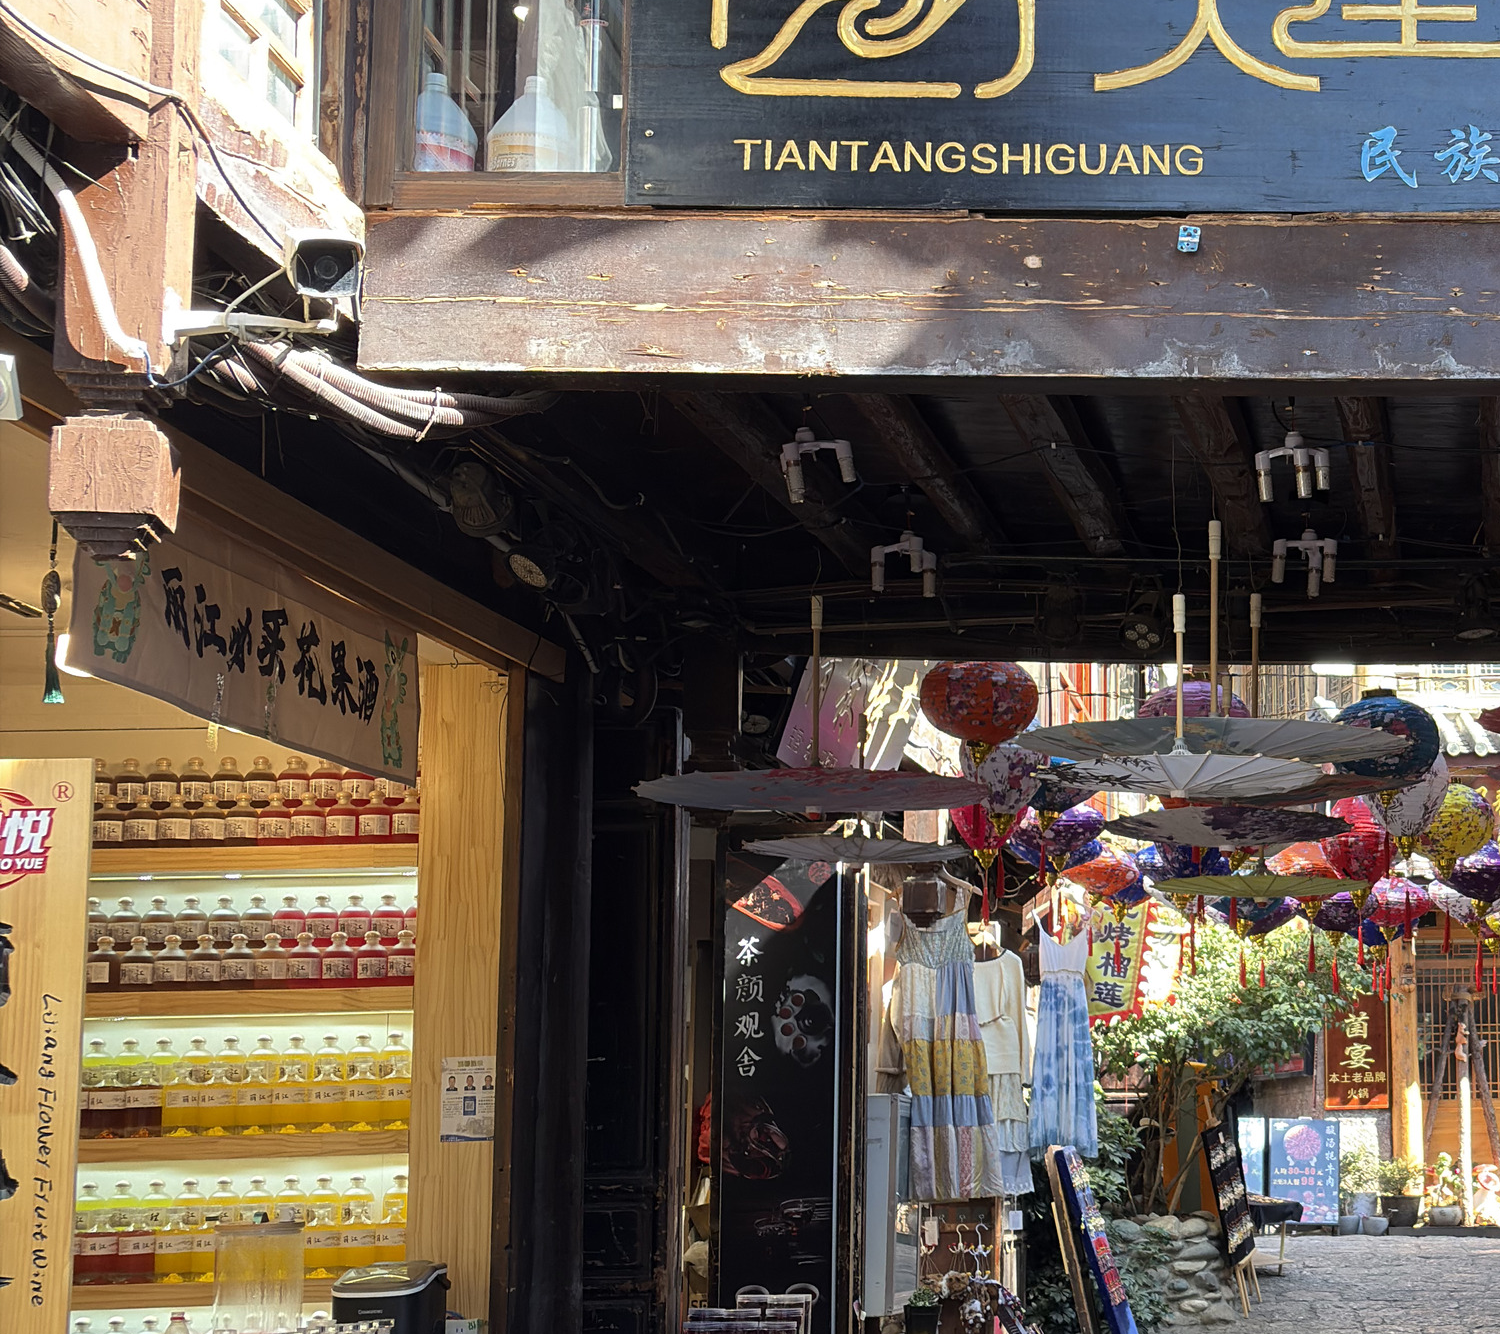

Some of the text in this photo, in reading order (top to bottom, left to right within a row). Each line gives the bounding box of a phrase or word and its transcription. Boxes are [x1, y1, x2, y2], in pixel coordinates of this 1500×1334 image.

[733, 138, 1204, 176] TIANTANGSHIGUANG
[14, 857, 45, 870] YUE
[733, 936, 765, 1078] 茶颜观舍
[1329, 1071, 1387, 1084] 本土老品牌
[1347, 1087, 1370, 1099] 火锅
[36, 1087, 57, 1169] Flower
[32, 1177, 53, 1241] Fruit
[30, 1248, 46, 1308] Wine
